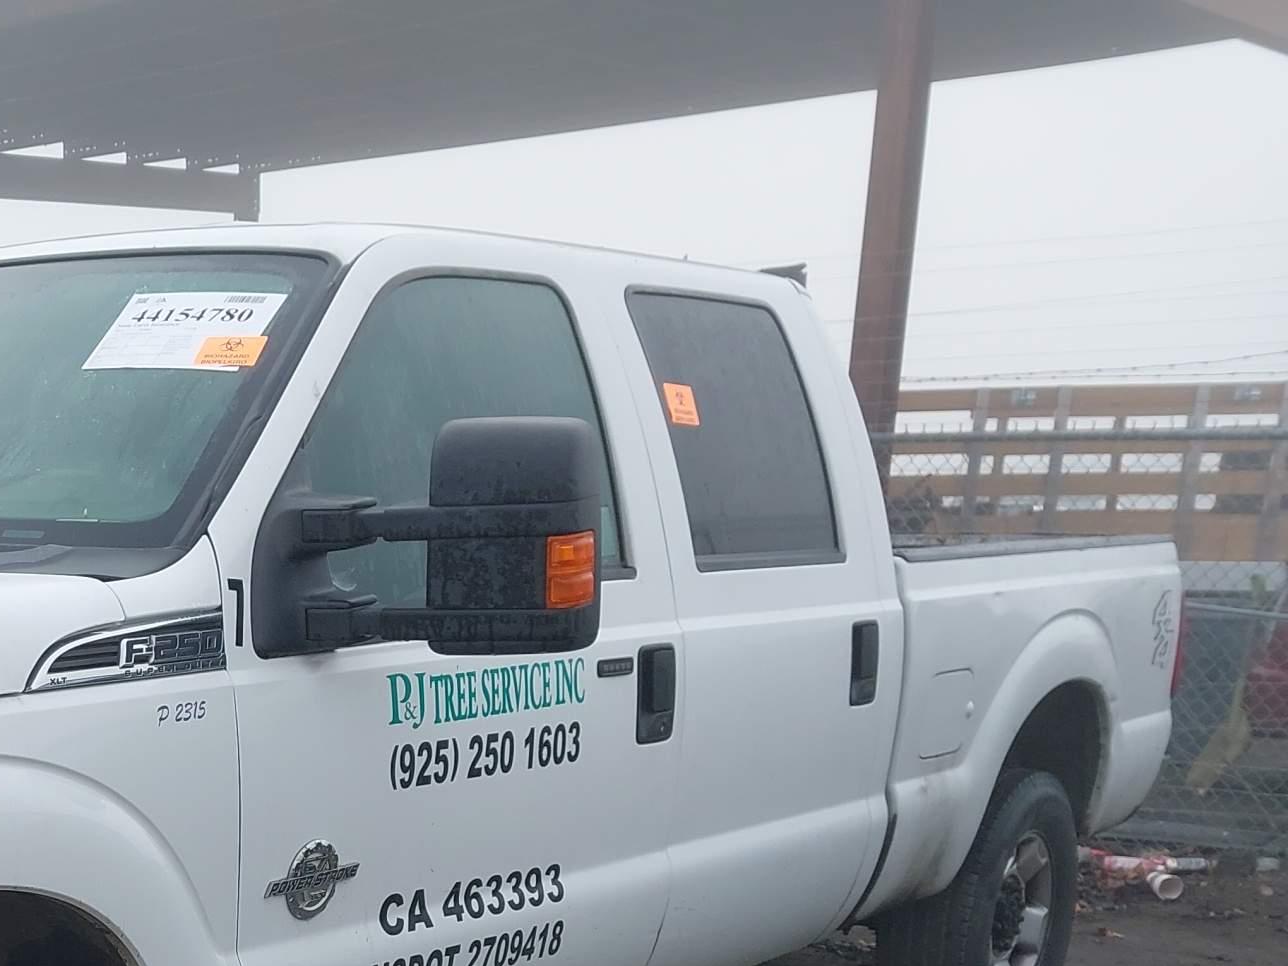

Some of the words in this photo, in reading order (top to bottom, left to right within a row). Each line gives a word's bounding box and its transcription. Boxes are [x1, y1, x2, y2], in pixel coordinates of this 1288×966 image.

[132, 307, 254, 323] 44154780
[49, 677, 68, 686] XLT
[387, 672, 427, 729] P&J
[430, 670, 478, 724] TREE
[481, 661, 553, 717] SERVICE
[555, 657, 586, 705] INC
[175, 700, 207, 722] 2315
[389, 738, 460, 791] (925)
[466, 730, 515, 779] 250
[523, 721, 582, 769] 1603
[269, 875, 314, 896] POWER
[314, 863, 361, 887] STROKE
[378, 889, 435, 936] CA
[442, 863, 565, 922] 463393
